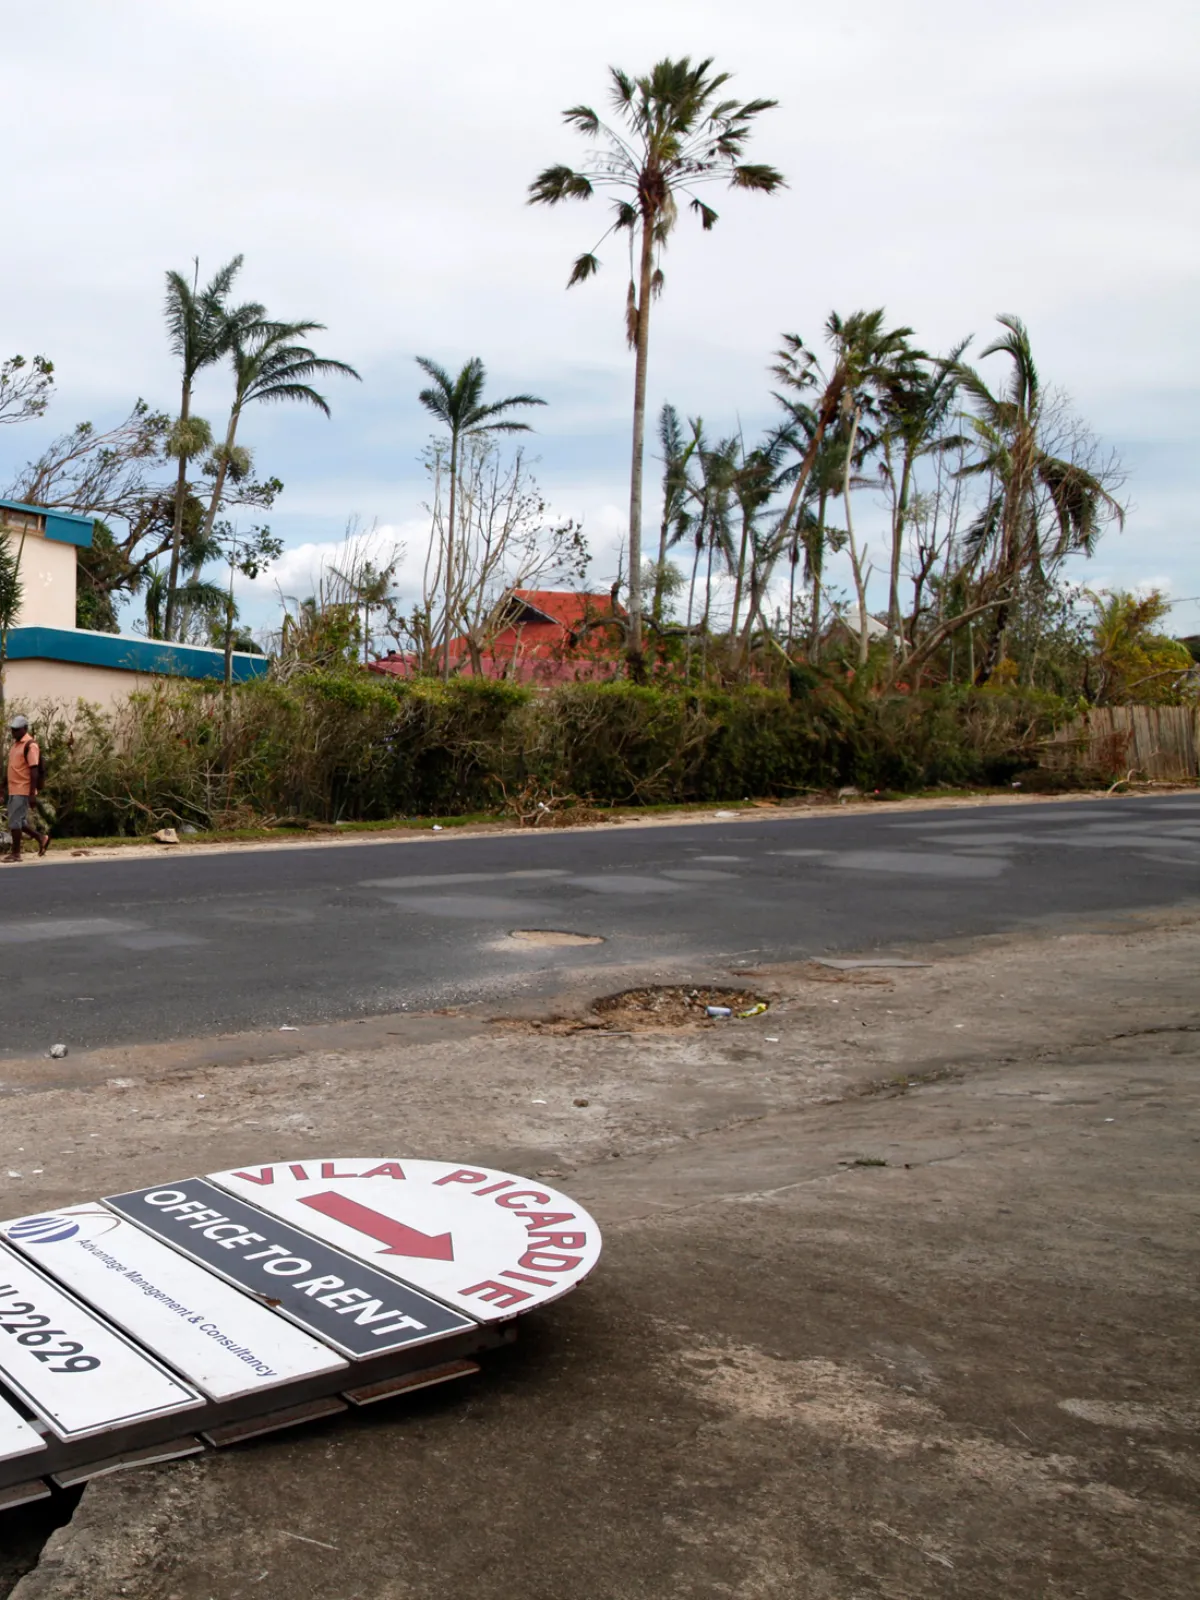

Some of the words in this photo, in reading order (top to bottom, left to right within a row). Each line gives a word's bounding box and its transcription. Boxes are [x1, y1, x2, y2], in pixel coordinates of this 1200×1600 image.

[76, 1238, 128, 1272] Advantage
[123, 1270, 194, 1317] Management
[188, 1314, 204, 1325] &
[198, 1322, 278, 1378] Consultancy
[143, 1190, 266, 1251] OFFICE
[253, 1244, 312, 1277] TO
[295, 1274, 428, 1337] RENT
[231, 1162, 407, 1187] VILA
[432, 1169, 587, 1309] PICARDIE
